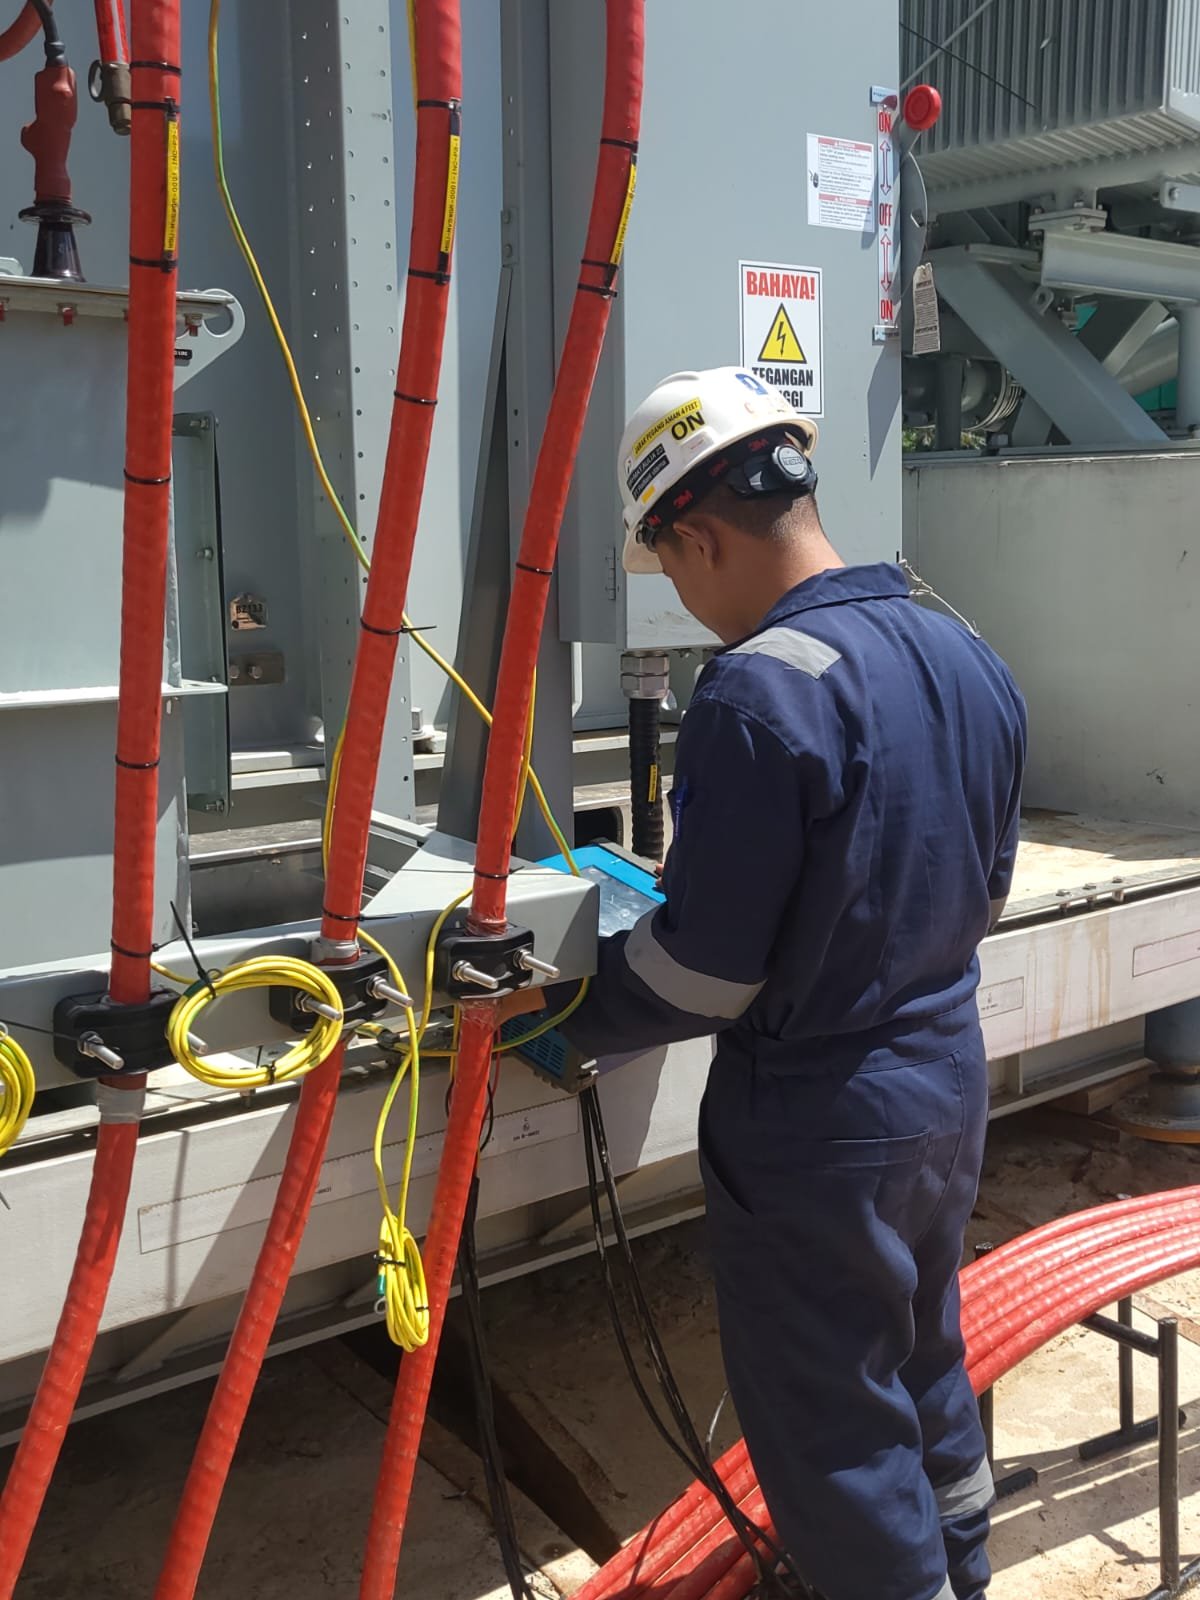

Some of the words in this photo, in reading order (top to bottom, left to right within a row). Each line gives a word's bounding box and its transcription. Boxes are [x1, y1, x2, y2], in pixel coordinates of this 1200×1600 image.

[878, 111, 893, 133] ON
[879, 202, 893, 226] OFF
[746, 270, 815, 300] BAHAYA!
[880, 299, 893, 320] ON
[684, 401, 699, 414] FEET
[671, 411, 705, 441] ON
